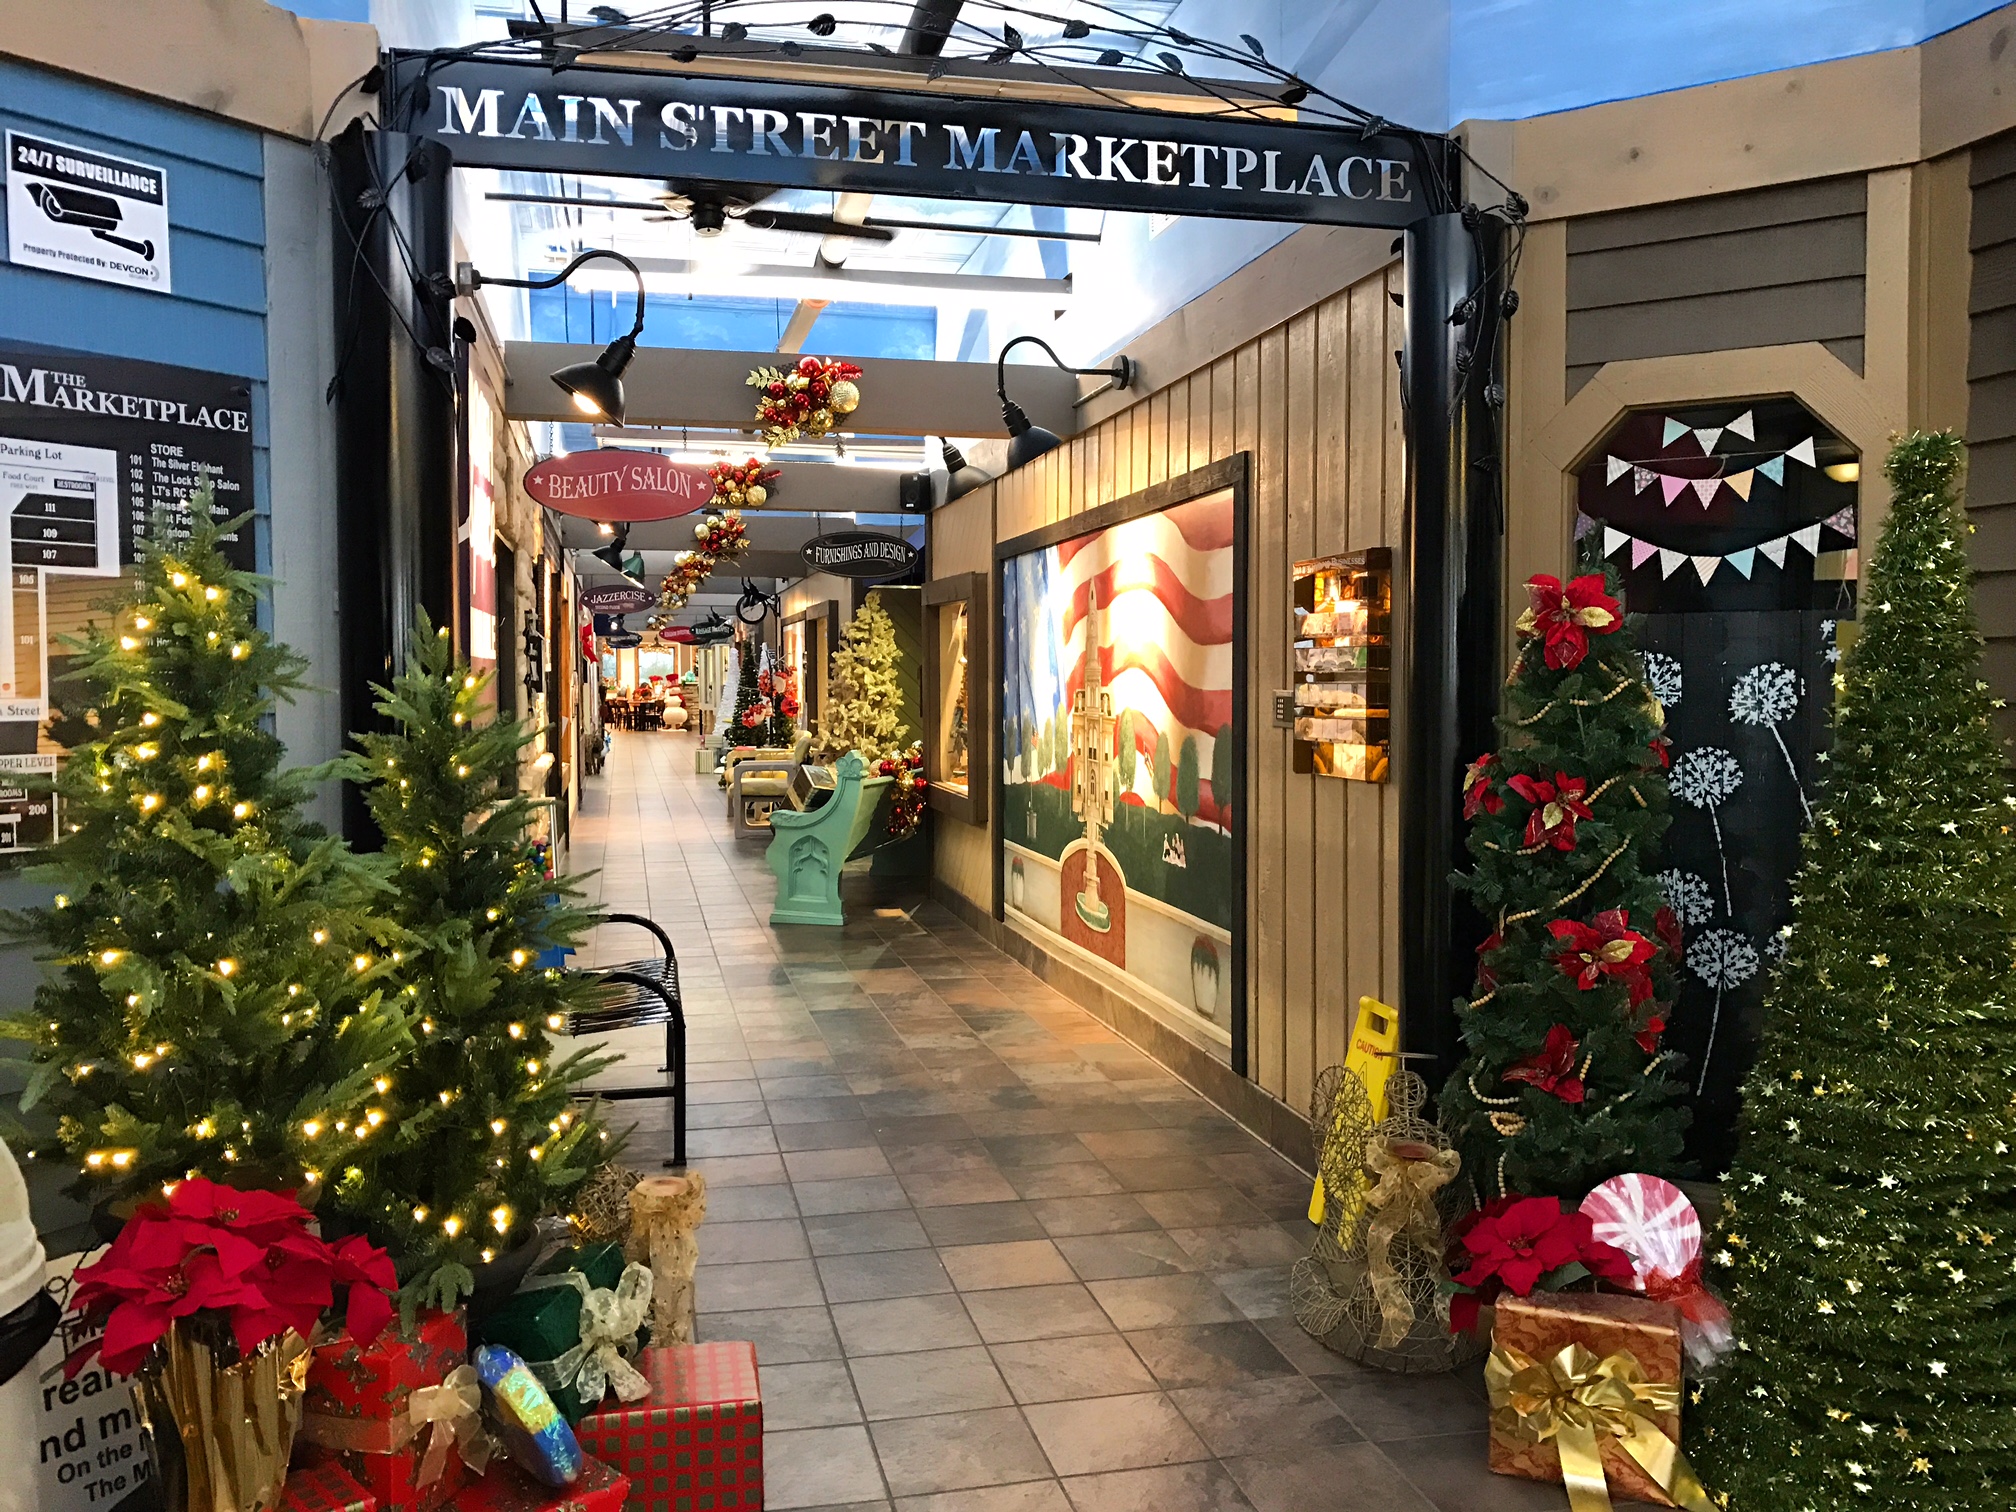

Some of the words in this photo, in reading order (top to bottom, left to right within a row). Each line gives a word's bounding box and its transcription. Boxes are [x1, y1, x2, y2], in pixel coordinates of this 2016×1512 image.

[436, 85, 641, 147] MAIN
[659, 100, 927, 169] STREET
[942, 122, 1413, 203] MARKETPLACE
[17, 145, 54, 169] 24/7
[55, 154, 158, 195] SURVEILLANCE
[23, 242, 57, 258] Property
[57, 250, 95, 266] Protected
[109, 261, 149, 277] DEVCON
[50, 371, 87, 388] THE
[0, 363, 249, 433] MARKETPLACE
[0, 442, 42, 460] Parking
[44, 448, 63, 461] Lot
[150, 443, 184, 458] STORE
[129, 454, 142, 466] 101
[151, 456, 167, 468] The
[168, 458, 190, 471] Silver
[191, 461, 224, 475] Elhant
[2, 471, 21, 481] Food
[23, 473, 45, 483] Court
[130, 468, 143, 480] 102
[152, 471, 169, 483] The
[171, 473, 192, 486] Lock
[193, 476, 216, 490] Sp
[217, 478, 240, 491] Salon
[548, 464, 629, 499] BEAUTY
[630, 466, 692, 499] SALON
[56, 481, 92, 491] RESTROOMS
[131, 482, 144, 494] 104
[152, 484, 171, 497] LT's
[173, 486, 187, 499] RC
[44, 502, 56, 513] 111
[131, 496, 144, 508] 105
[152, 498, 191, 515] Massag
[132, 510, 145, 522] 106
[42, 528, 58, 539] 109
[132, 525, 145, 536] 107
[42, 549, 57, 560] 107
[815, 544, 862, 565] FURNISHINGS
[863, 542, 879, 558] AND
[879, 541, 906, 563] DESIGN
[590, 590, 646, 604] JAZZERCISE
[20, 635, 34, 646] 101
[7, 705, 40, 717] Street
[25, 756, 54, 768] LEVEL
[28, 803, 48, 816] 200
[57, 1460, 91, 1484] On
[97, 1443, 133, 1468] the
[83, 1475, 127, 1502] The
